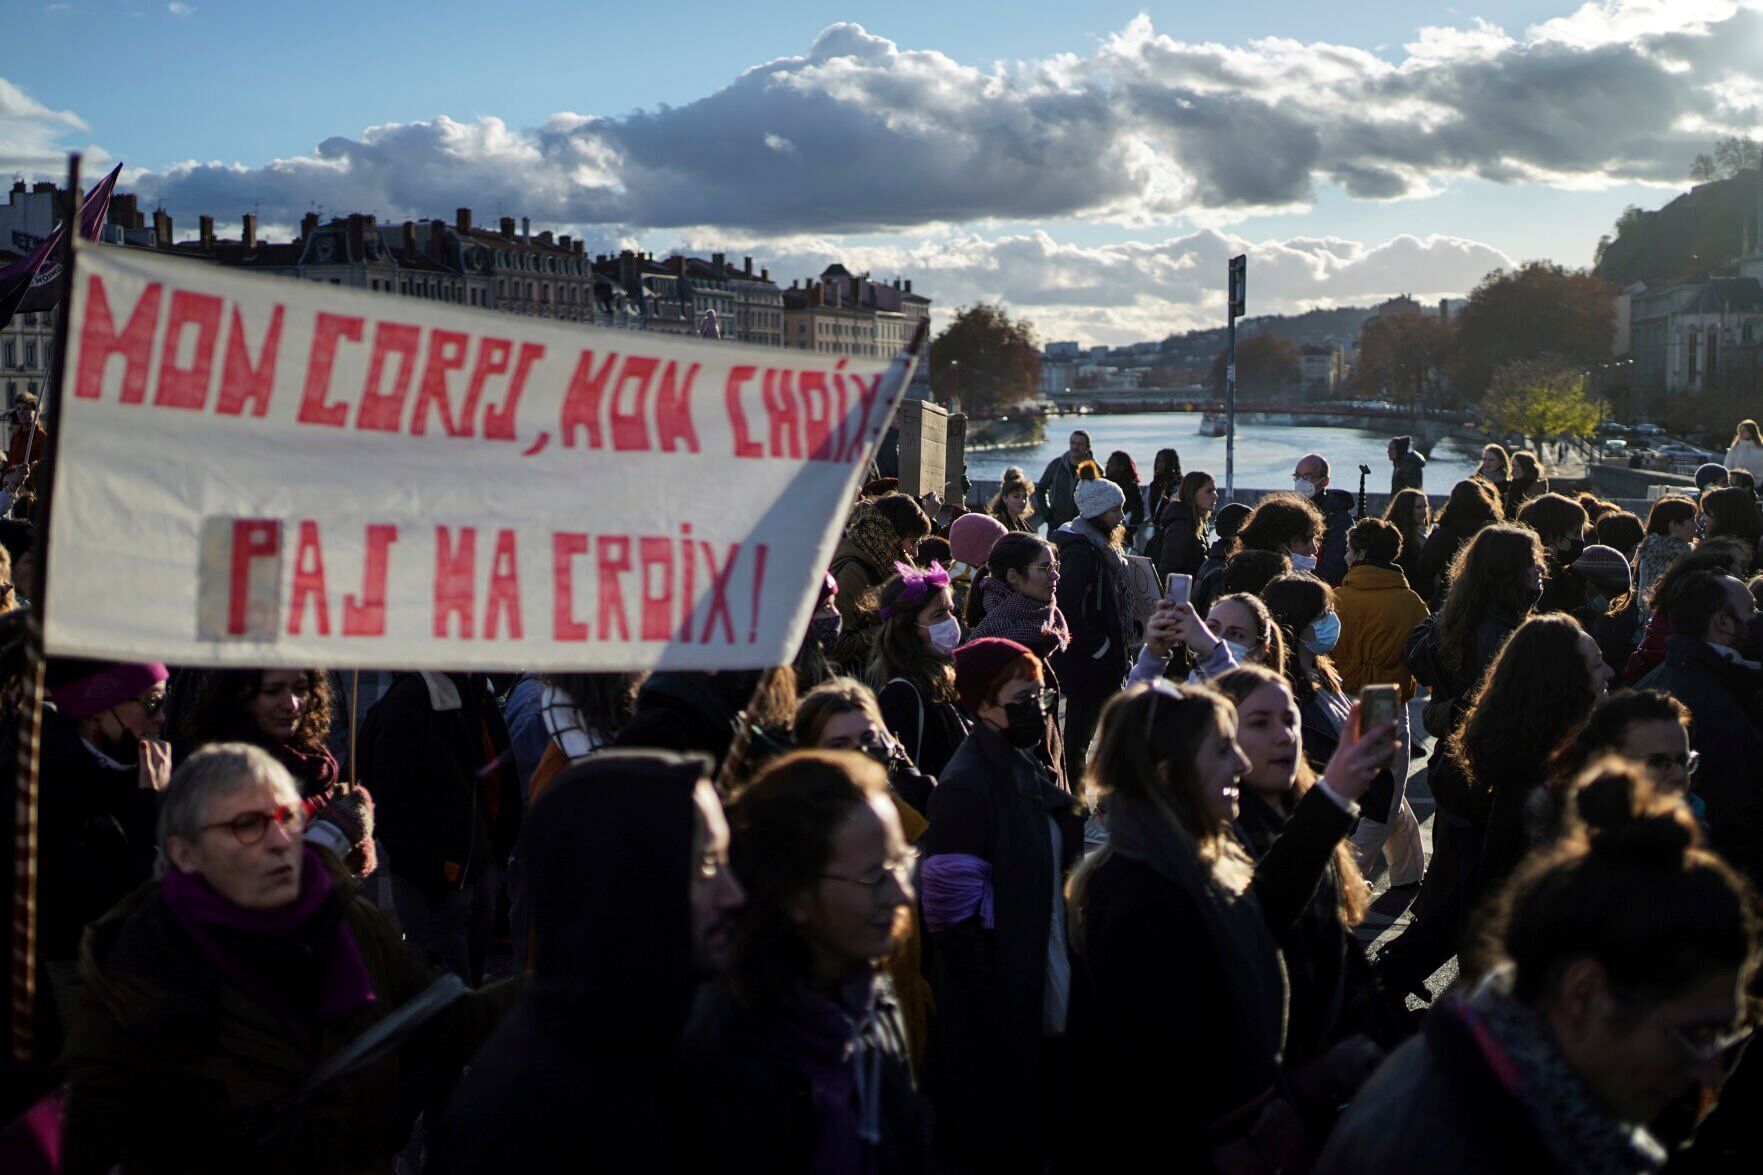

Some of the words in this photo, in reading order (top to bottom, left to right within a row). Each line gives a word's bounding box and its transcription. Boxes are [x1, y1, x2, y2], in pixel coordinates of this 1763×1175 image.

[74, 274, 285, 417] MON
[561, 349, 701, 453] MON
[227, 519, 398, 637] PAS
[434, 525, 523, 640] MA
